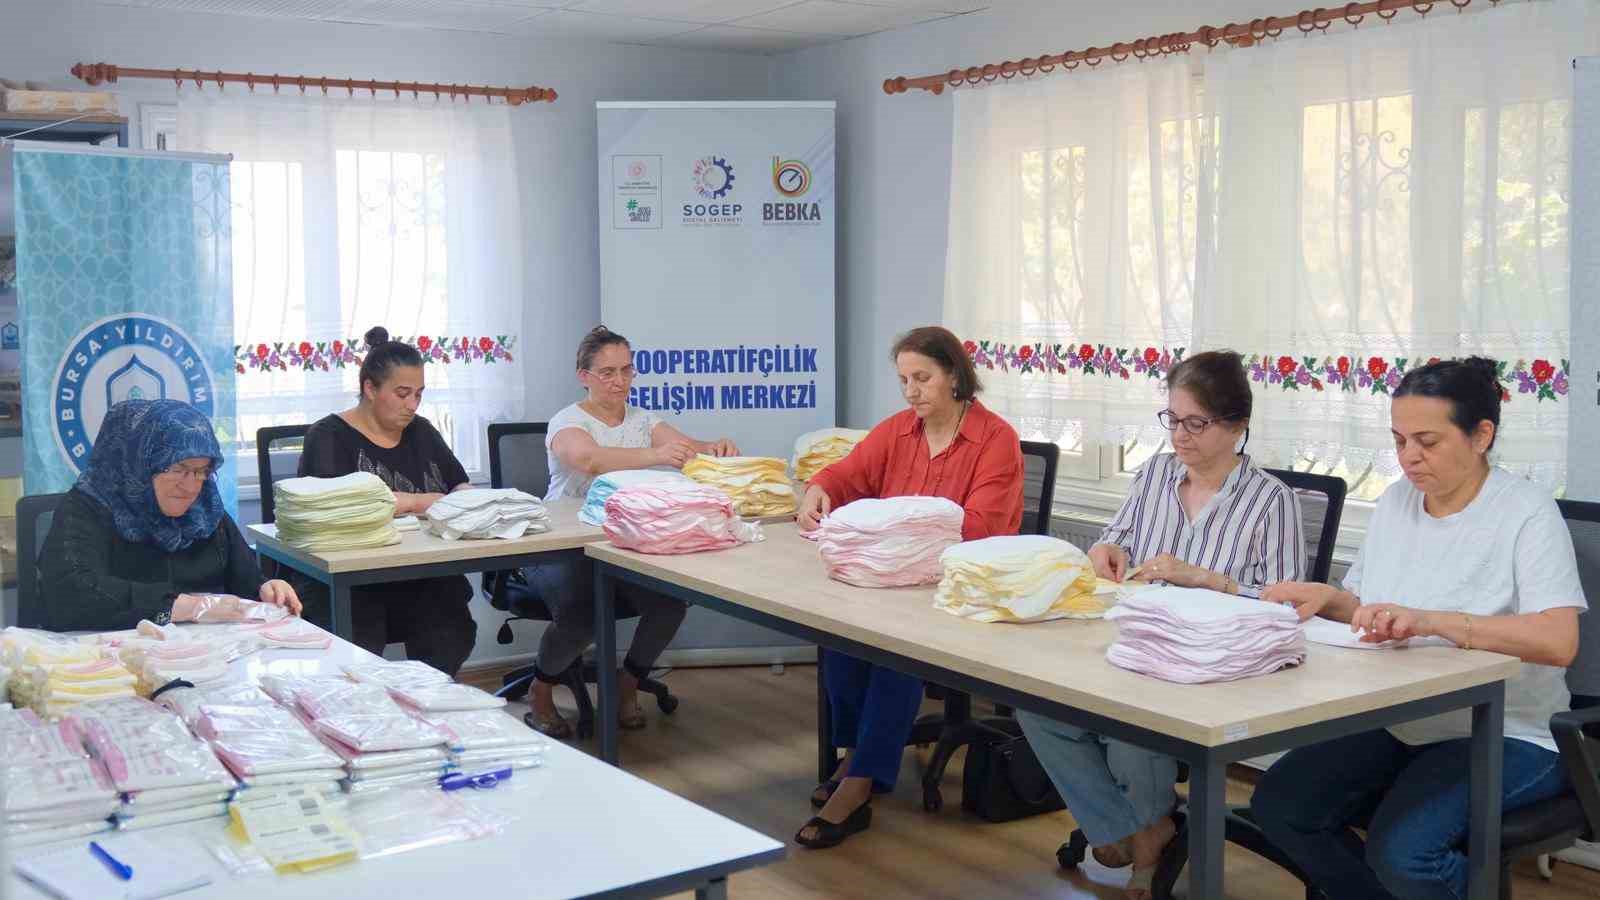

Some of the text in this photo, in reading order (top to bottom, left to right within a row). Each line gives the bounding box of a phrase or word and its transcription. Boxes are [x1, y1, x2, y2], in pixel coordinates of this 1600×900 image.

[683, 204, 743, 216] SOGEP
[763, 203, 821, 220] BEBKA
[61, 325, 208, 421] BURSA YILDIRIM
[721, 380, 816, 409] MERKEZİ
